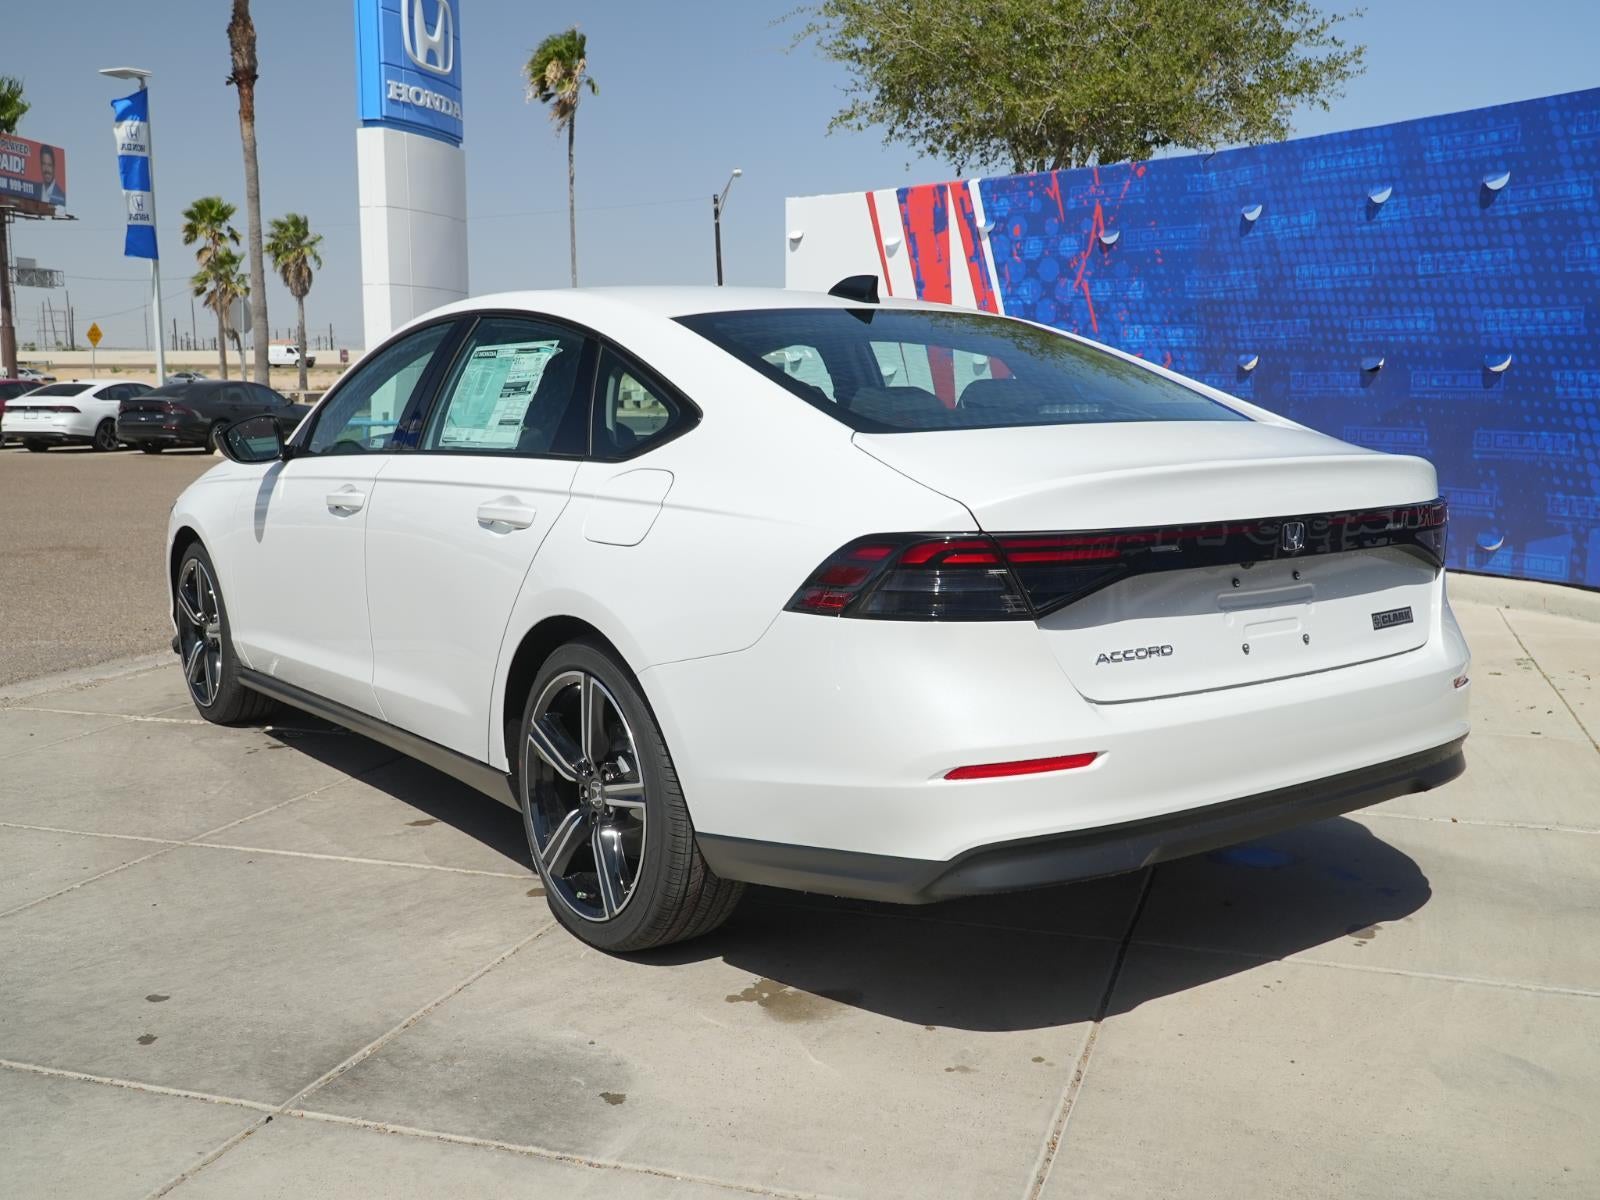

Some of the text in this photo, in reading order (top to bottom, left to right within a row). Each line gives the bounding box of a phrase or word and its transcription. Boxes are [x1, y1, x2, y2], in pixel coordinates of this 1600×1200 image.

[387, 80, 463, 120] HONDA
[0, 153, 25, 175] AID!
[1495, 433, 1570, 451] CLARK
[1381, 610, 1411, 625] CLARK
[1095, 644, 1174, 666] ACCORD
